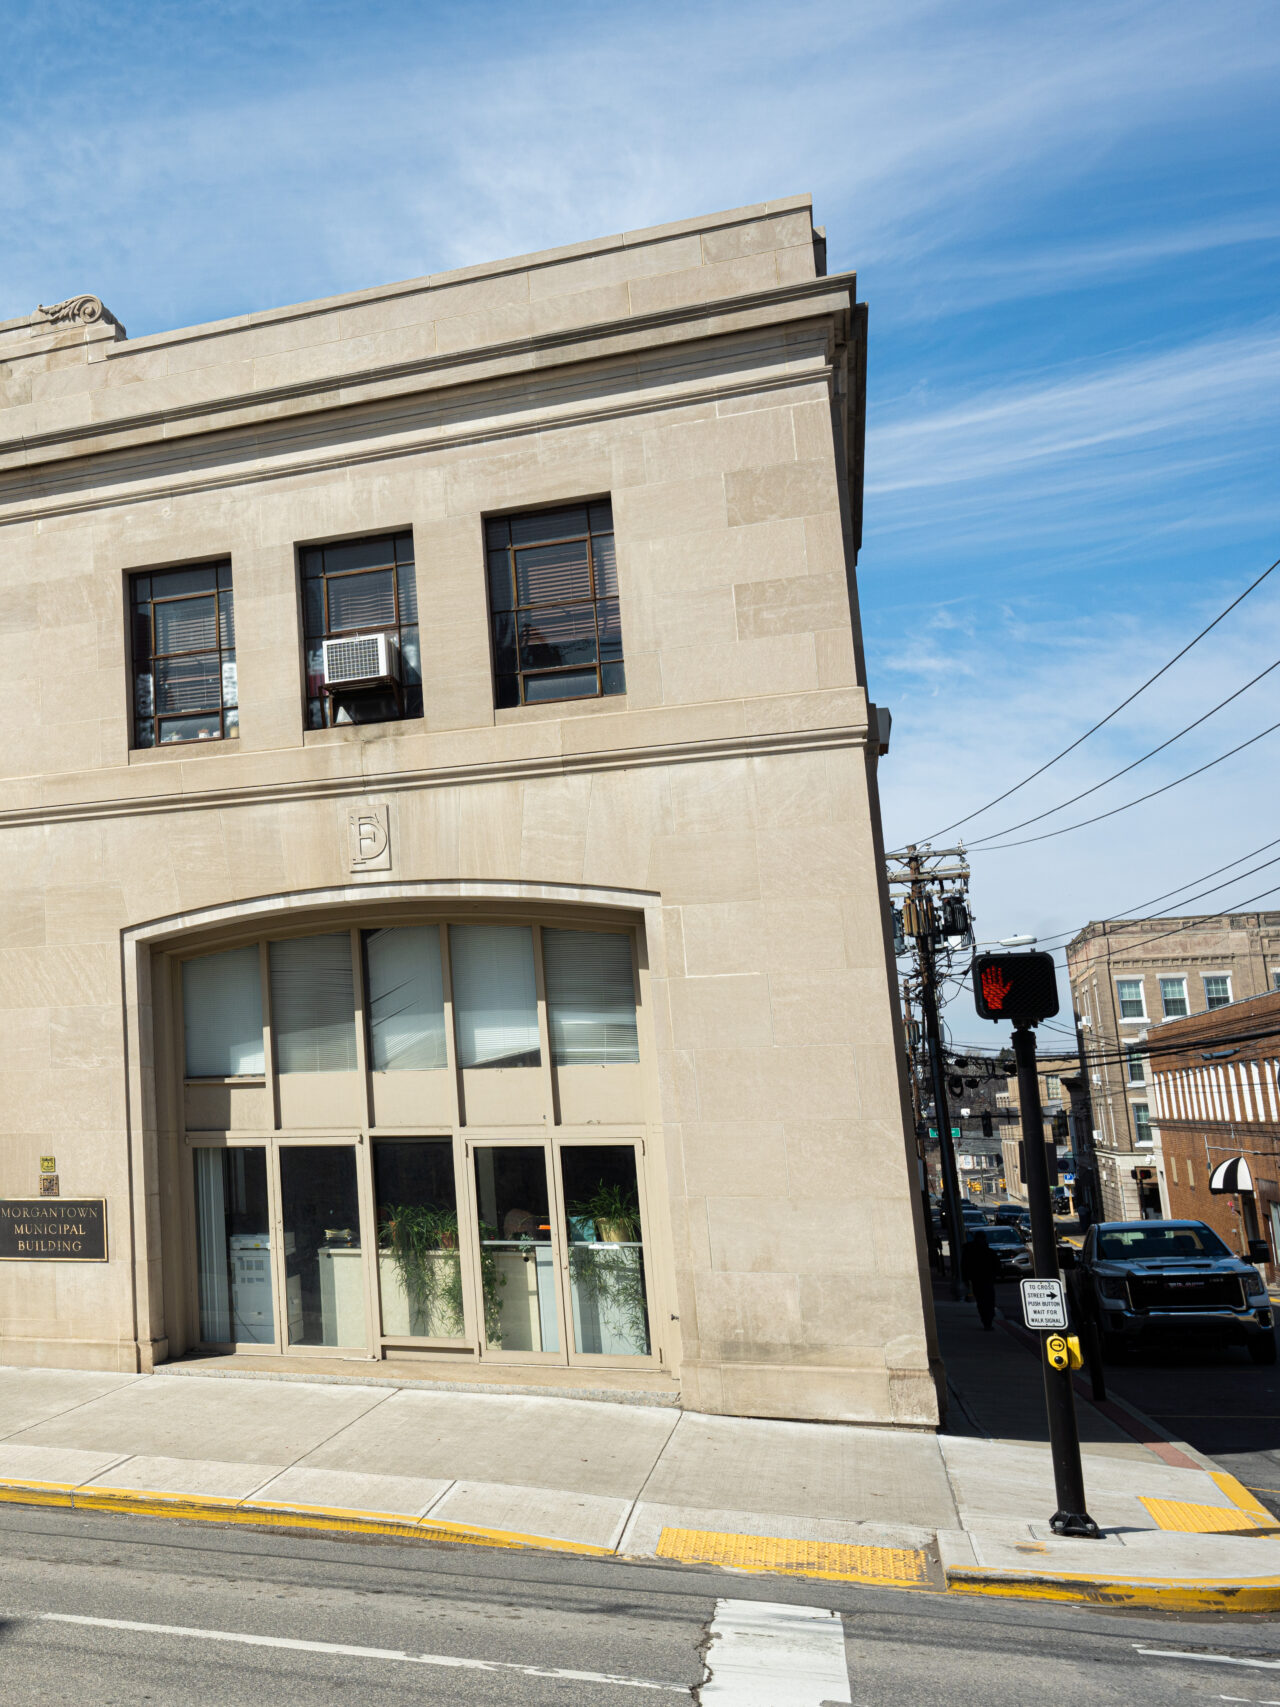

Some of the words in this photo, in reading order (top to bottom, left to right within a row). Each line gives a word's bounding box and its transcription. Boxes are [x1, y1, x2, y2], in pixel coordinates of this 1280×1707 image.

[1, 1207, 97, 1218] MORGANTOWN
[14, 1224, 86, 1235] MUNICIPAL
[18, 1240, 82, 1252] BUILDING
